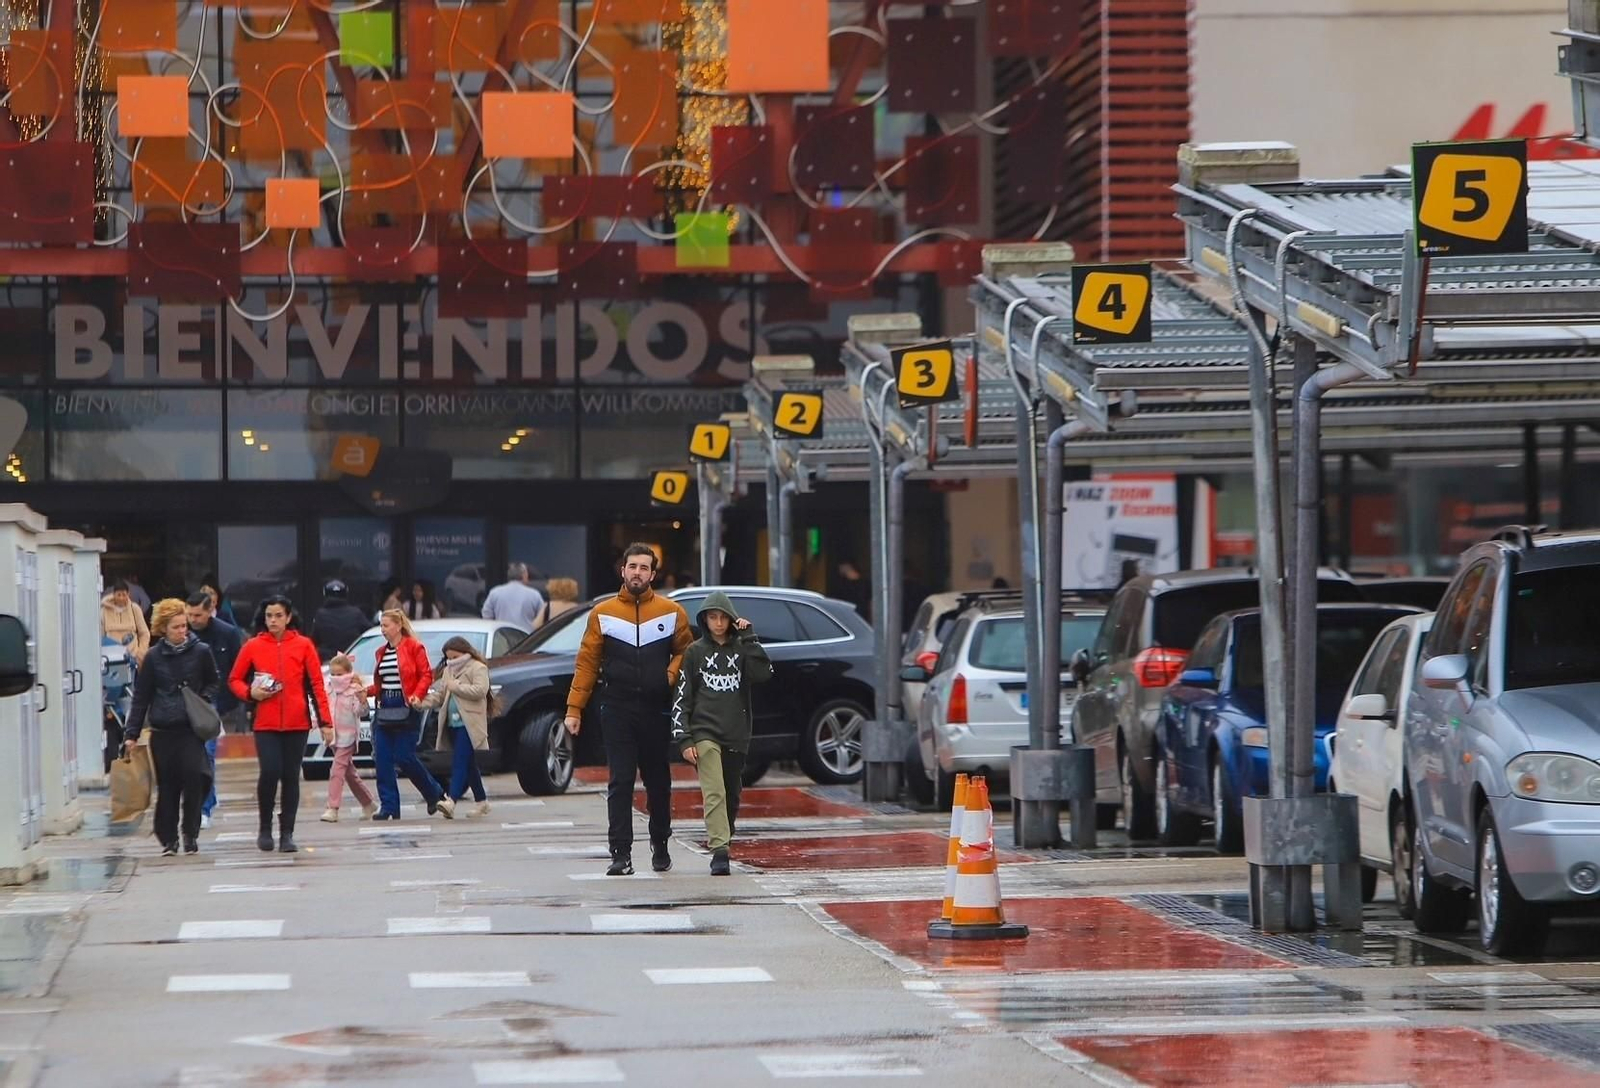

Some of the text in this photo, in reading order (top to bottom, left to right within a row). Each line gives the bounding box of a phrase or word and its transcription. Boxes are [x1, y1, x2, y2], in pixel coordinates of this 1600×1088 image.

[1452, 169, 1490, 222] 5
[1097, 283, 1127, 320] 4
[54, 301, 770, 381] BIENVENIDOS
[913, 359, 936, 388] 3
[789, 401, 807, 425] 2
[703, 431, 714, 451] 1
[662, 478, 676, 496] 0
